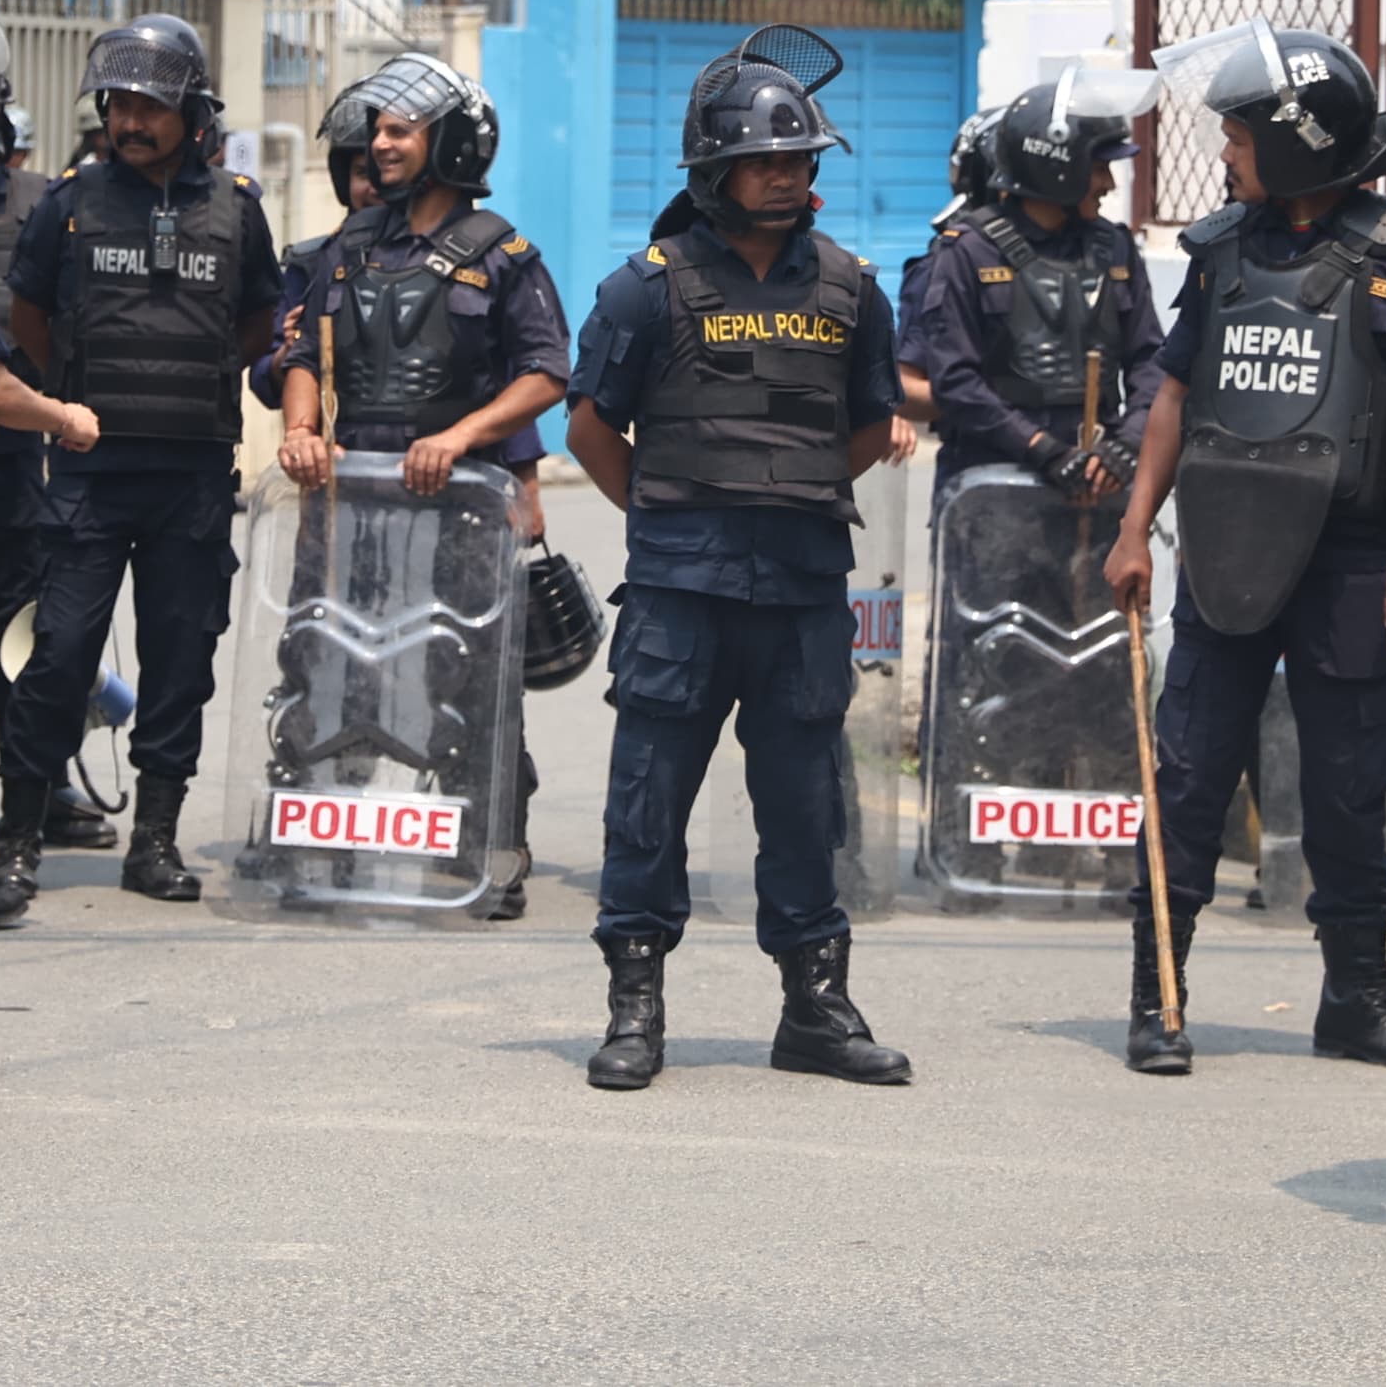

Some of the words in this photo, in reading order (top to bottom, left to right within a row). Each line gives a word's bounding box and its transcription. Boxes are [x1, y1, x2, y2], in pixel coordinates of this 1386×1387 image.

[1291, 65, 1330, 87] LICE
[1022, 137, 1070, 162] NEPAL
[93, 246, 149, 275] NEPAL
[178, 251, 217, 281] LICE
[704, 314, 773, 343] NEPAL
[775, 313, 845, 344] POLICE
[1223, 325, 1321, 360] NEPAL
[1219, 361, 1319, 395] POLICE
[852, 598, 901, 651] OLICE
[277, 799, 454, 850] POLICE
[977, 800, 1140, 840] POLICE
